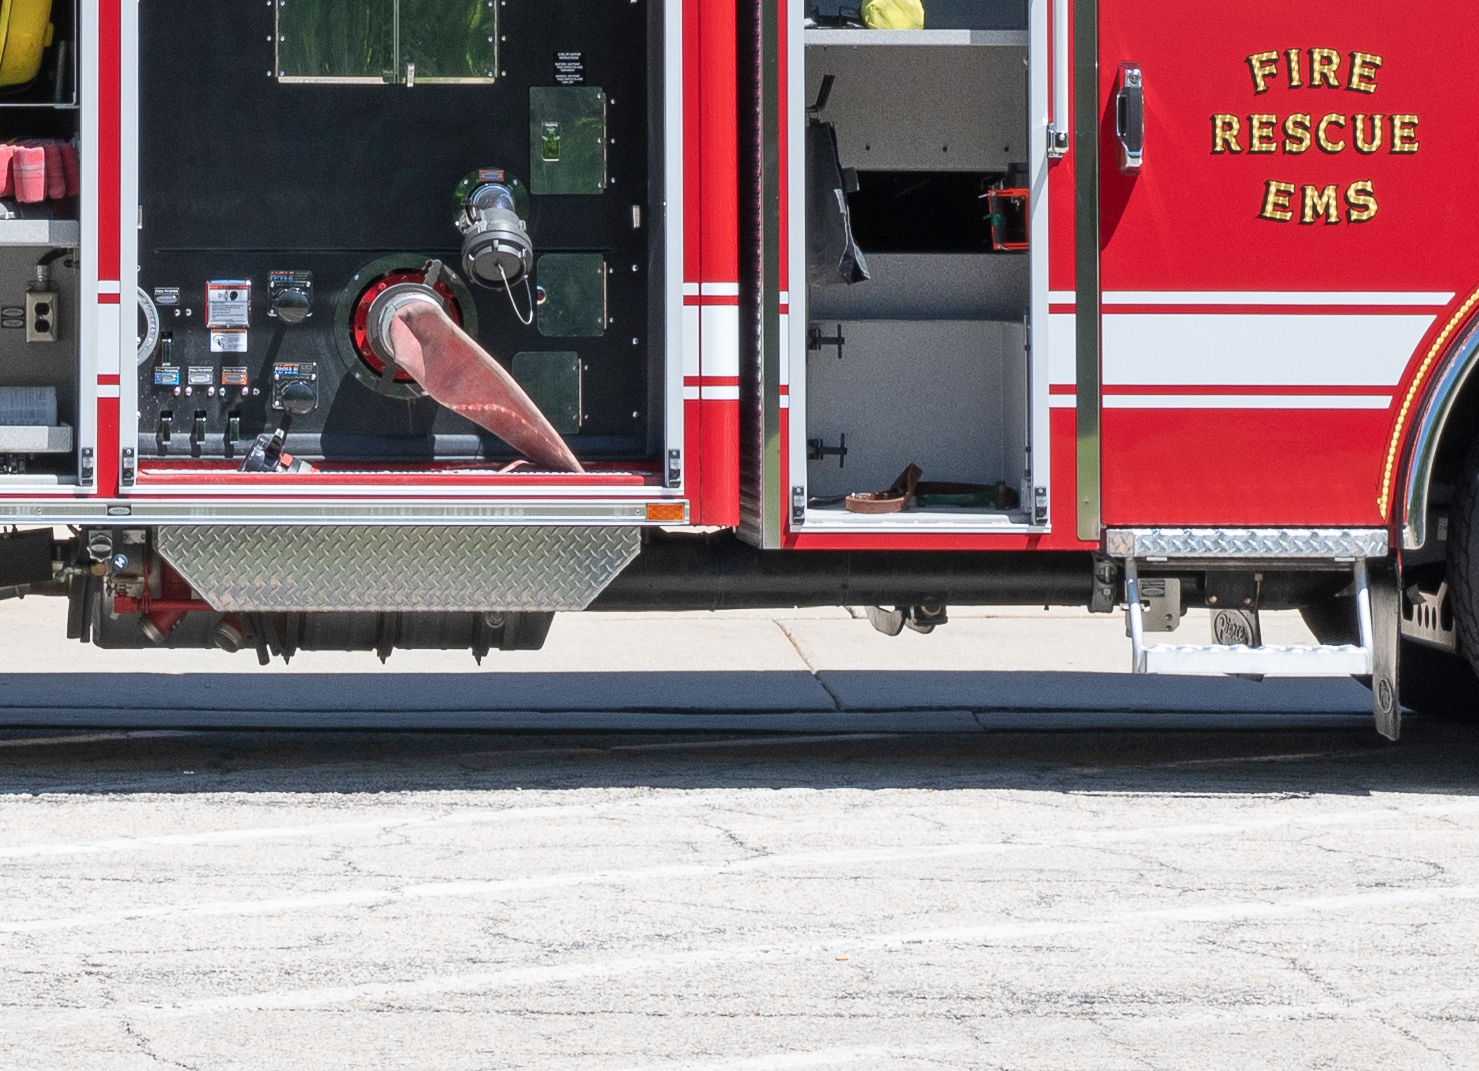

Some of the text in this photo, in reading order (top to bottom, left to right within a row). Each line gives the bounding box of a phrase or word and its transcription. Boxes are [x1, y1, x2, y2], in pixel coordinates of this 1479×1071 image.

[1245, 47, 1384, 95] FIRE
[1211, 113, 1421, 155] RESCUE
[1258, 179, 1380, 225] EMS
